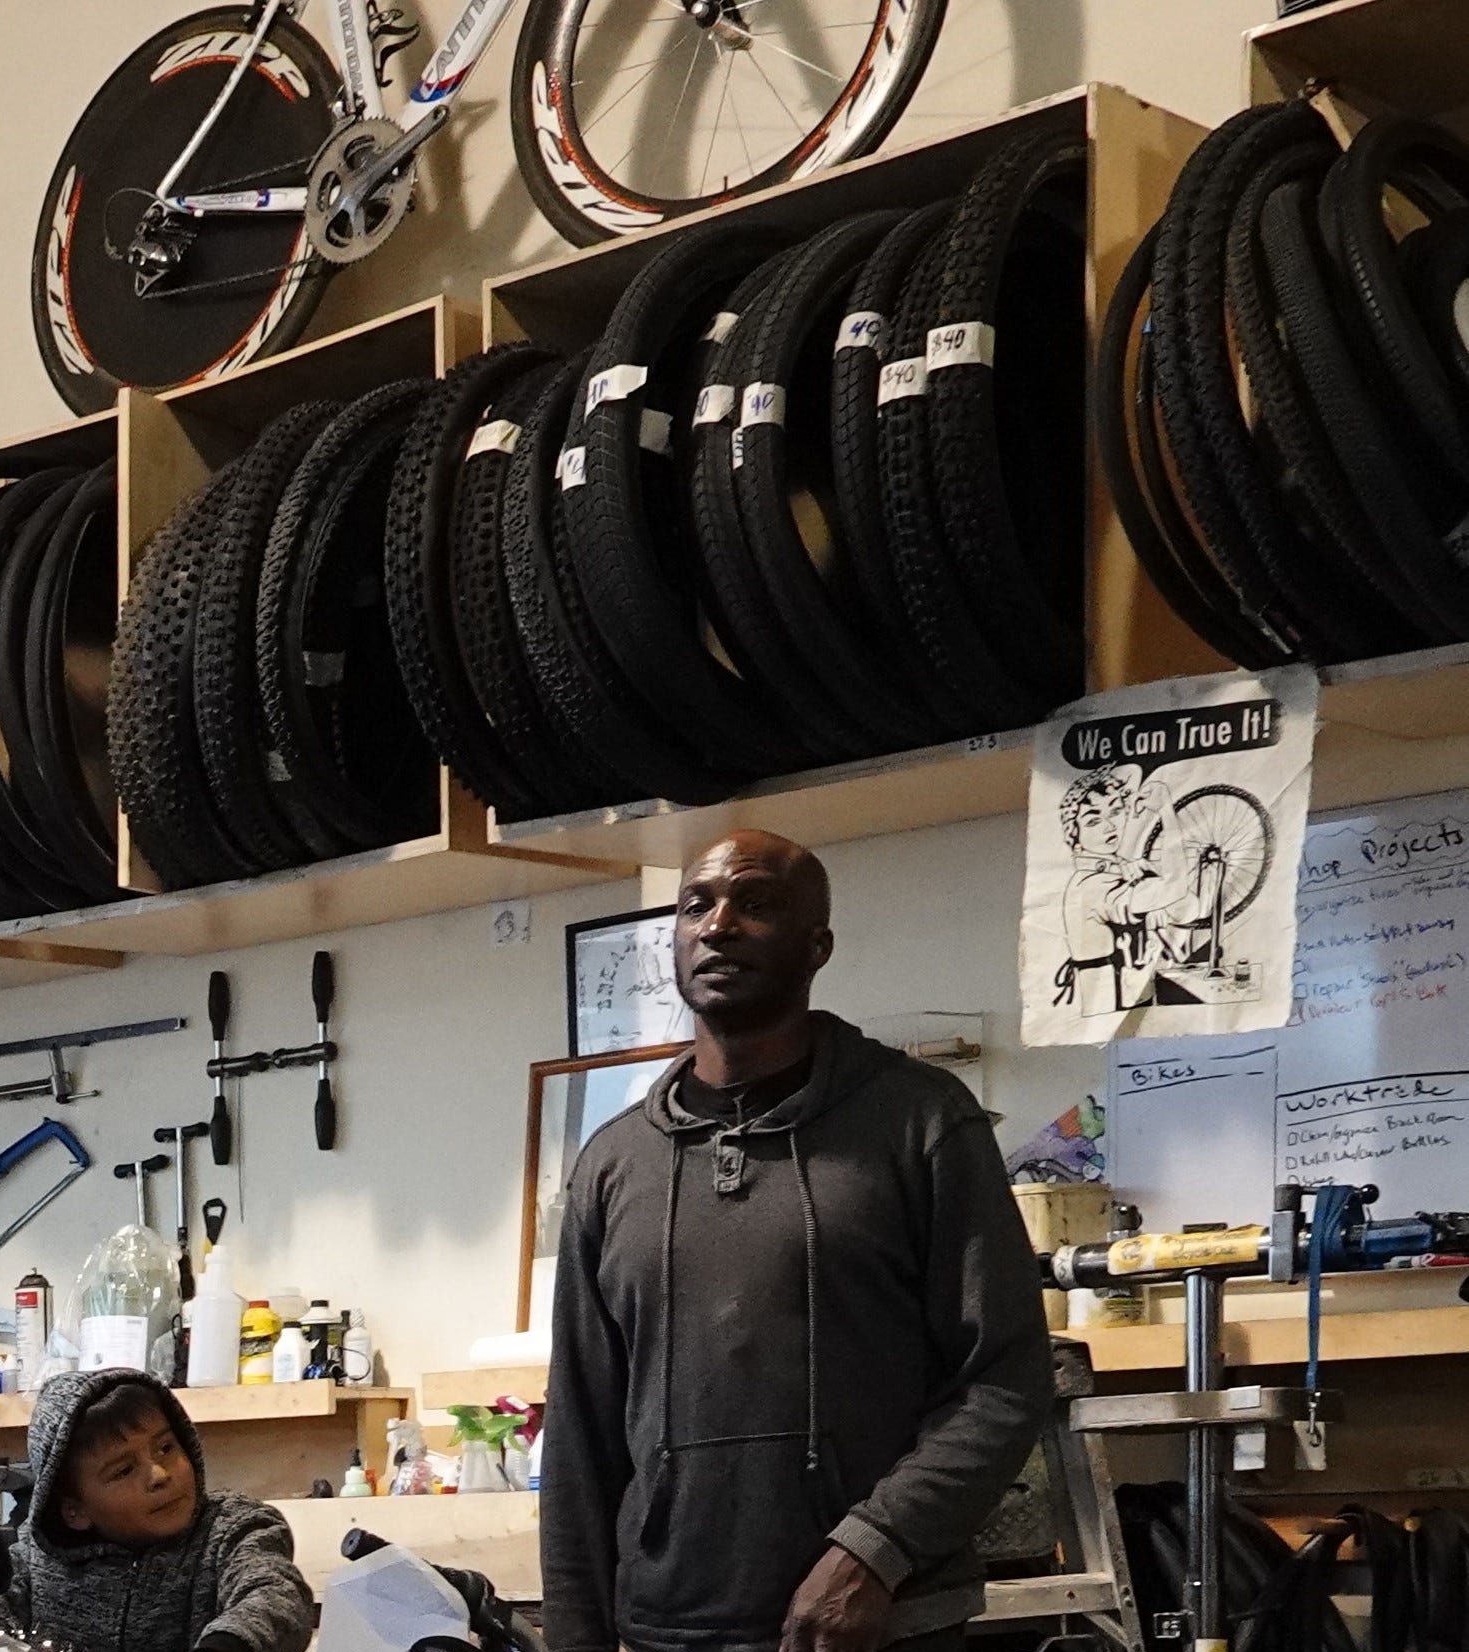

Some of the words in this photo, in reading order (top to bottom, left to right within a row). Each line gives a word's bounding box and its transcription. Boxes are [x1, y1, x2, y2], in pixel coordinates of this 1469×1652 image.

[1078, 729, 1112, 762] We
[1121, 725, 1166, 757] Can
[1176, 718, 1232, 750] True
[1242, 709, 1272, 742] It!
[1362, 822, 1464, 869] Projects
[1131, 1065, 1195, 1085] Bikes
